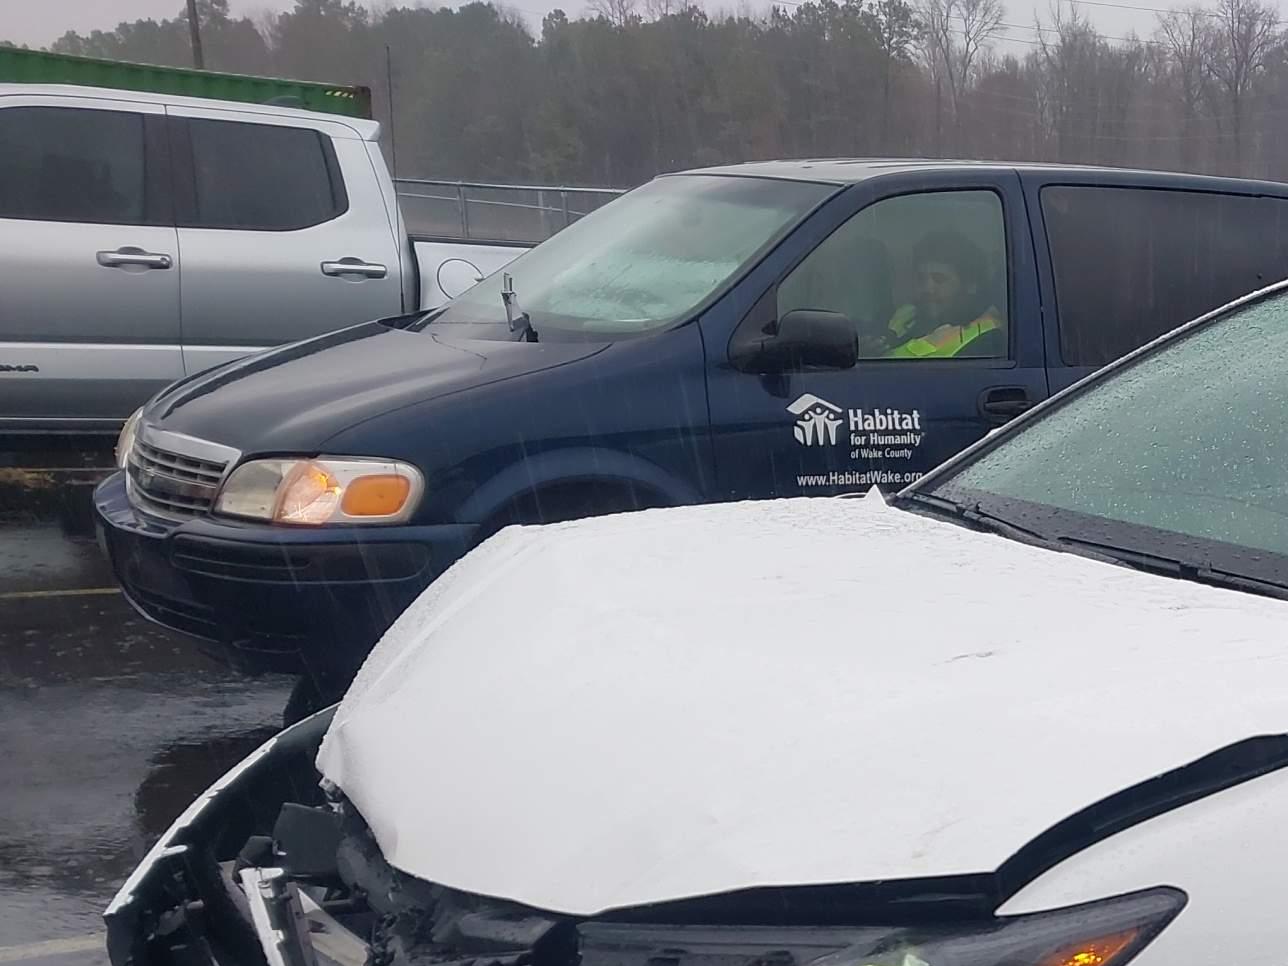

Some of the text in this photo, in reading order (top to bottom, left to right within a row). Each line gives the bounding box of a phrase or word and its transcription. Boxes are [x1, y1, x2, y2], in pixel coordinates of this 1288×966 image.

[848, 408, 921, 431] Habitat
[850, 432, 921, 447] for Humanity
[850, 447, 913, 460] of Wake County
